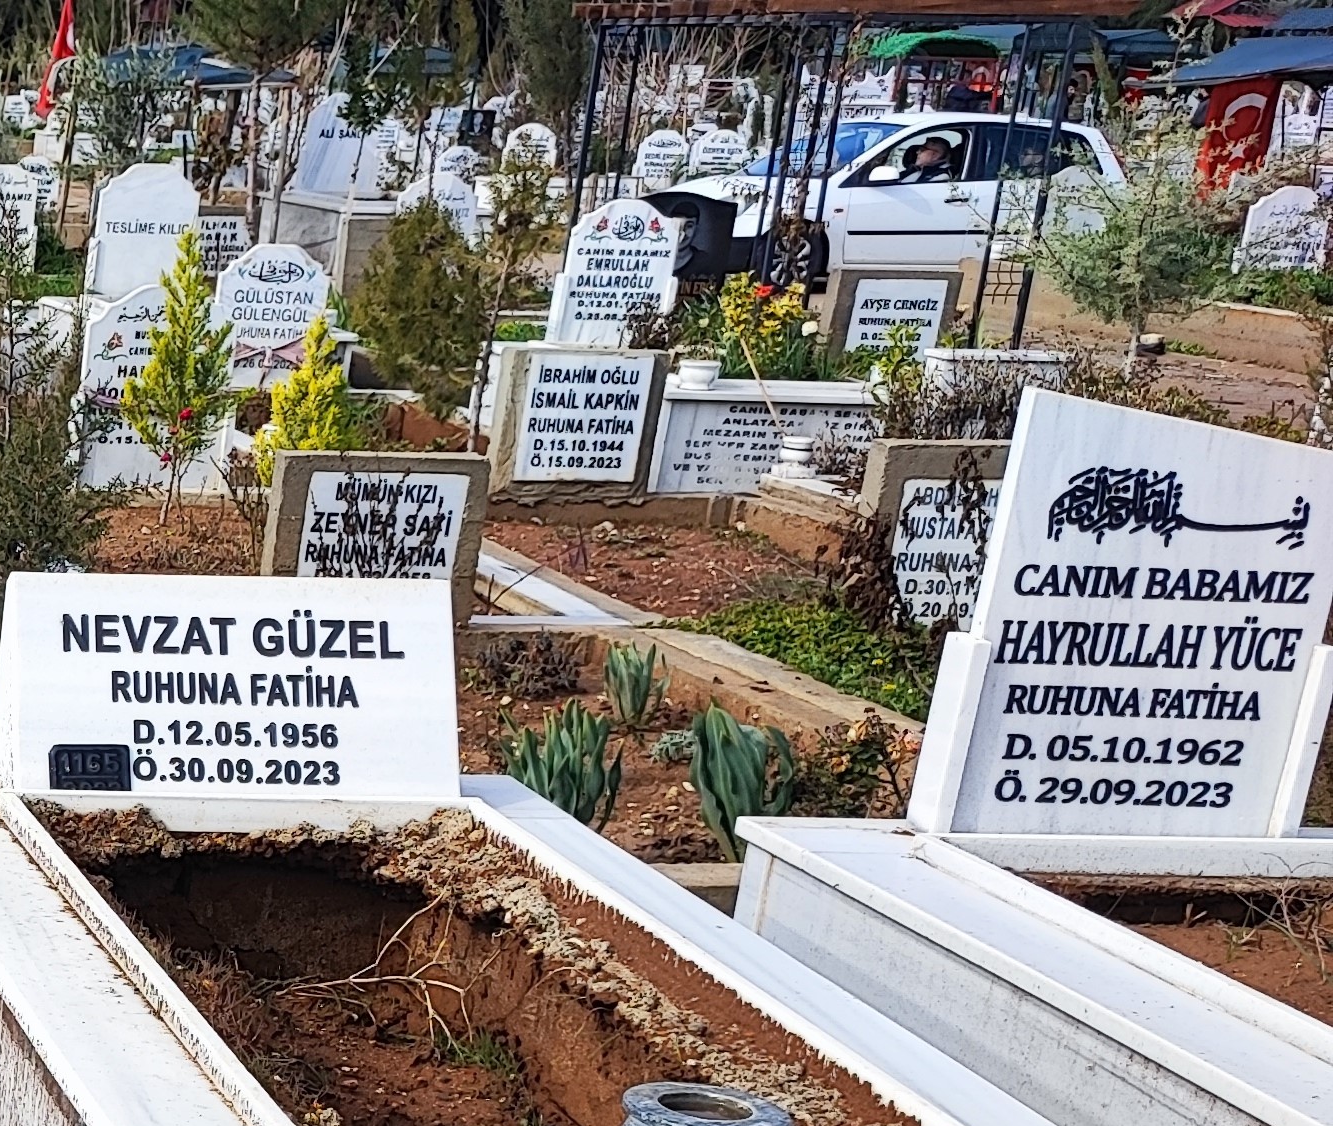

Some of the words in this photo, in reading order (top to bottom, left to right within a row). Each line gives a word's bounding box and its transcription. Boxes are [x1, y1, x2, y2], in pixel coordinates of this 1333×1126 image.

[105, 218, 157, 234] TESLİME
[586, 257, 651, 272] EMRULLAH
[576, 273, 654, 289] DALLAROĞLU
[234, 287, 315, 305] GÜLÜSTAN
[859, 298, 892, 313] AYŞE
[893, 298, 939, 312] CENGİZ
[231, 305, 311, 323] GÜLENGÜL
[538, 363, 597, 386] İBRAHİM
[602, 365, 640, 387] OĞLU
[530, 386, 581, 409] İSMAİL
[583, 390, 640, 412] KAPKİN
[526, 416, 583, 435] RUHUNA
[586, 413, 635, 436] FATİHA
[533, 439, 624, 453] D.15.10.1944
[530, 453, 622, 471] Ö.15.09.2023
[403, 484, 439, 504] KIZI
[1013, 564, 1140, 599] CANIM
[1142, 567, 1315, 605] BABAMIZ
[61, 612, 238, 656] NEVZAT
[251, 608, 405, 660] GÜZEL
[993, 619, 1208, 669] HAYRULLAH
[1211, 615, 1303, 673] YÜCE
[111, 670, 242, 706] RUHUNA
[250, 664, 360, 709] FATİHA
[1003, 684, 1140, 717] RUHUNA
[1145, 682, 1261, 722] FATİHA
[132, 718, 340, 750] D.12.05.1956
[59, 751, 121, 773] 1165
[1046, 734, 1245, 767] 05.10.1962
[132, 747, 341, 786] Ö.30.09.2023
[1034, 777, 1235, 809] 29.09.2023
